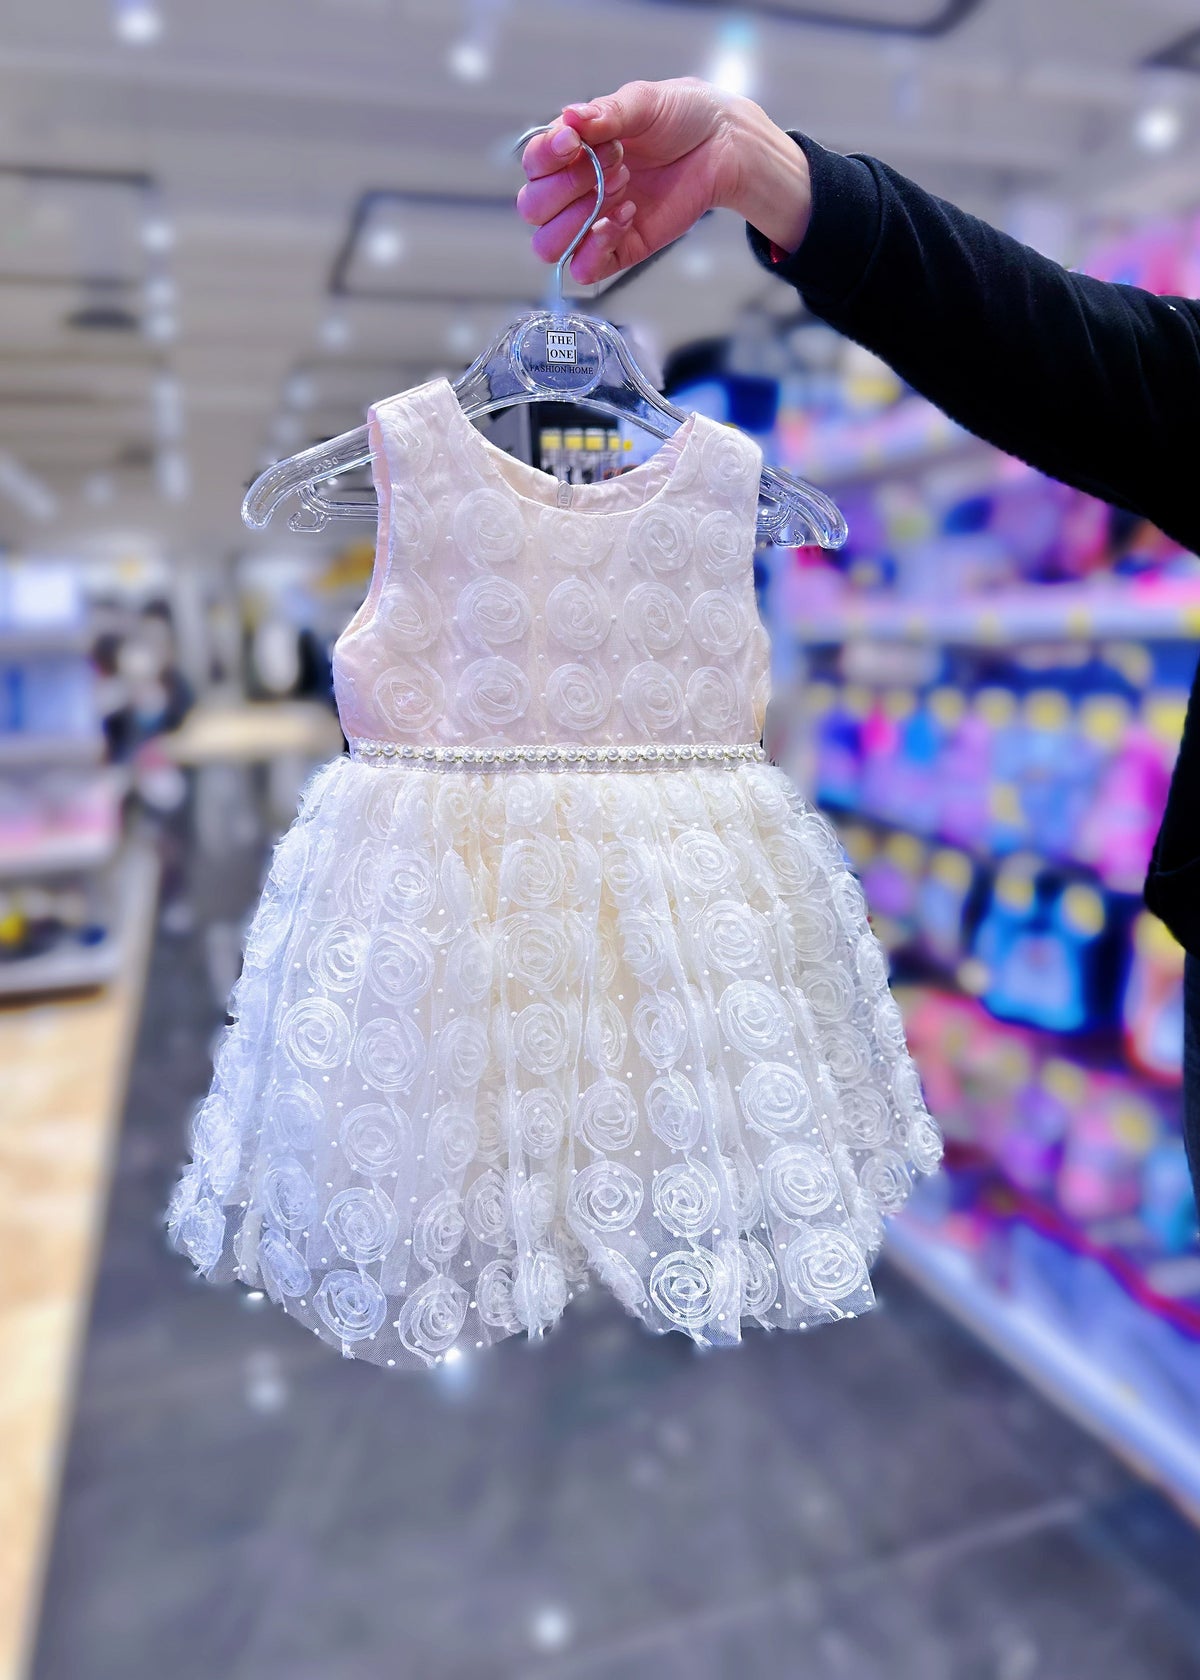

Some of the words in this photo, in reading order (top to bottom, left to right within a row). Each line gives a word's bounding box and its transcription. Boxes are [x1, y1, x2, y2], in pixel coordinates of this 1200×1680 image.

[549, 335, 573, 345] THE
[550, 349, 573, 359] ONE
[530, 364, 567, 374] FASHION
[569, 366, 594, 375] HOME
